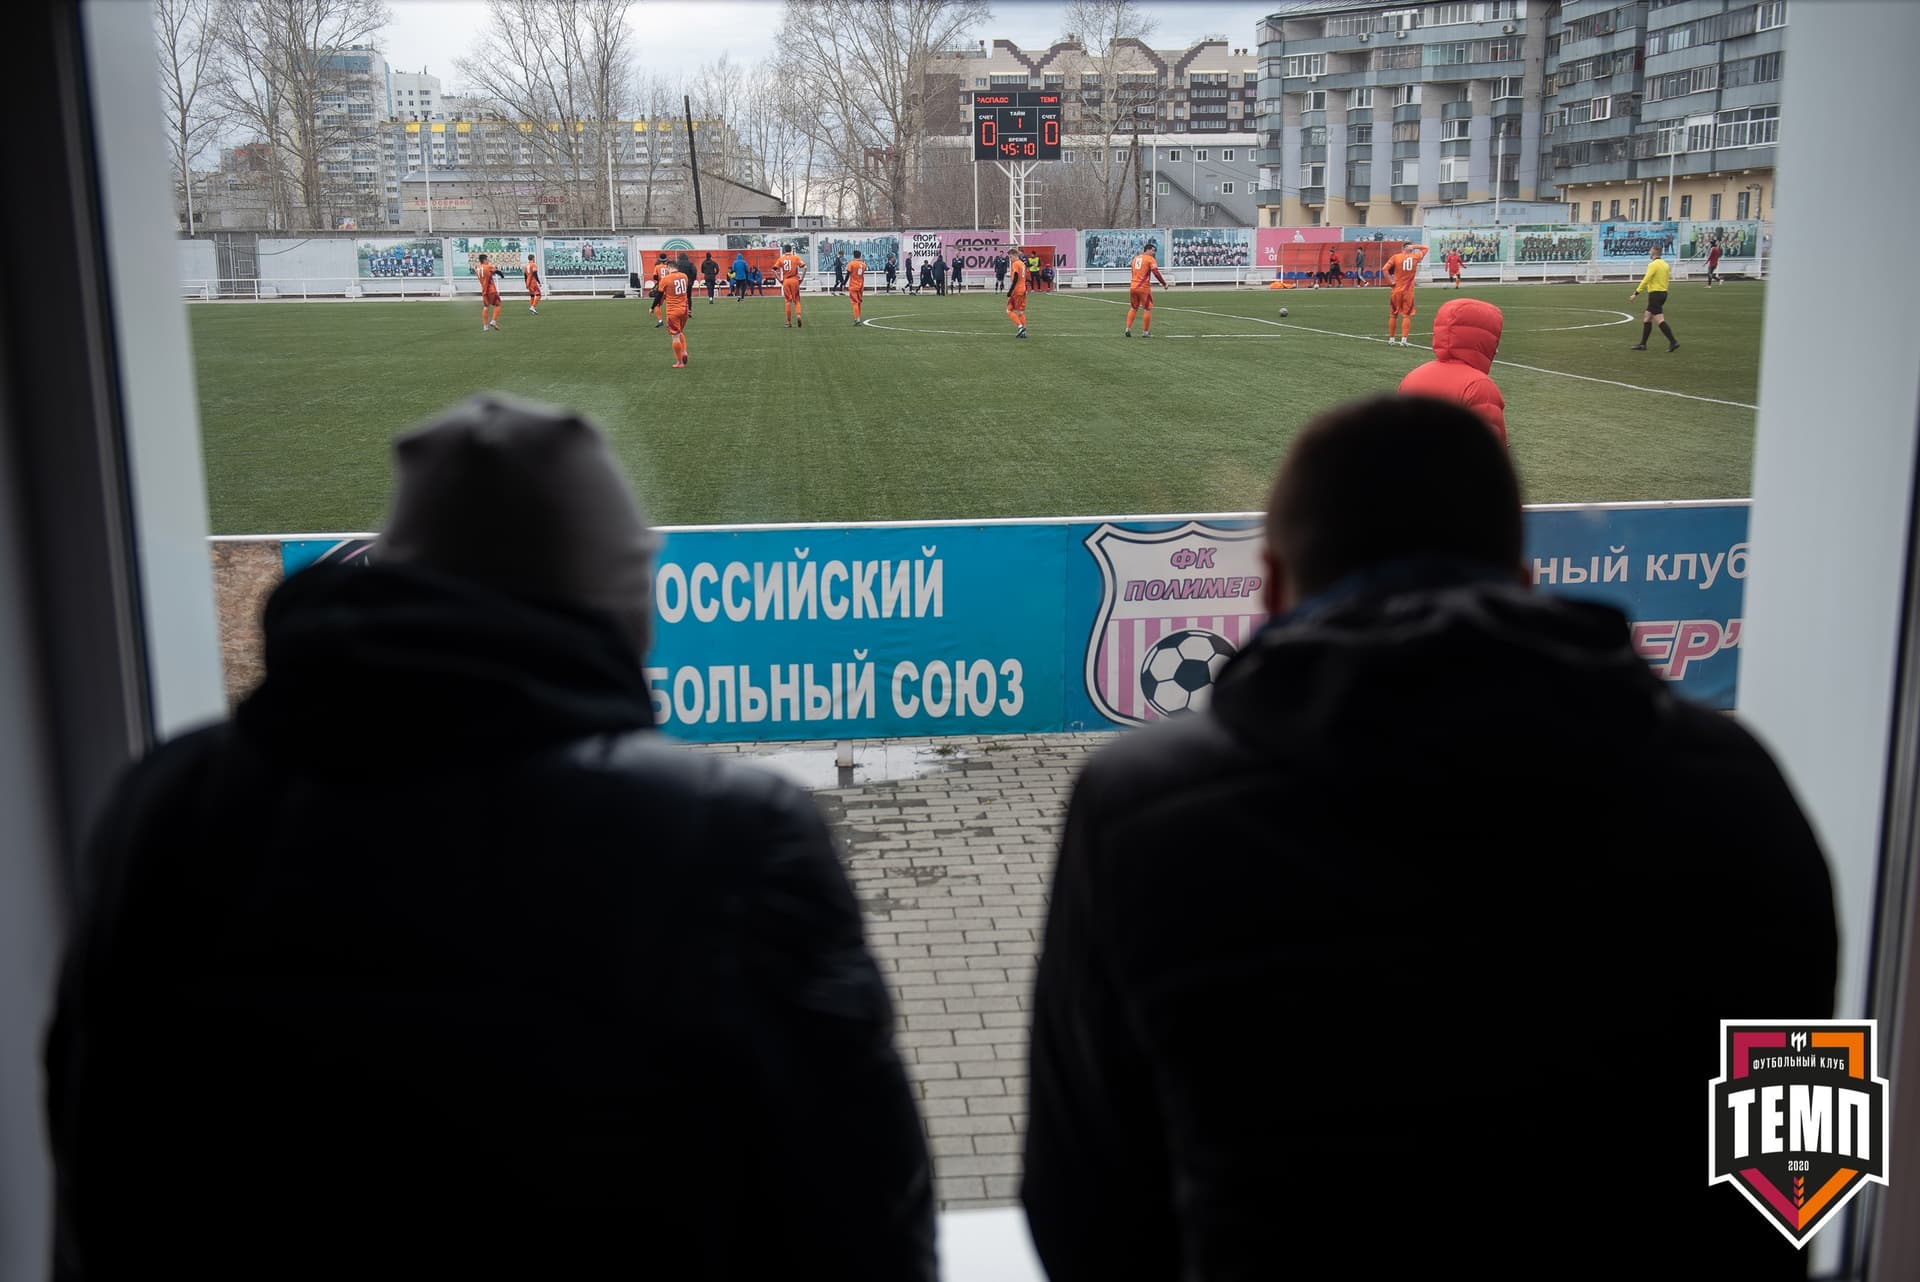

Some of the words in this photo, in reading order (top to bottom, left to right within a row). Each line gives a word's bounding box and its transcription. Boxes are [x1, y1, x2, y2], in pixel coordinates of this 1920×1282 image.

[1018, 117, 1022, 129] 1
[982, 121, 996, 146] 0
[1044, 120, 1059, 146] 0
[1000, 142, 1036, 156] 45:10
[913, 234, 937, 242] СПОРТ
[955, 238, 1000, 251] СПОРТ
[913, 242, 942, 250] НОРМА
[913, 250, 942, 258] ЖИЗНИ
[783, 259, 792, 273] 21
[673, 278, 687, 295] 20
[1170, 547, 1218, 570] ФК
[1646, 542, 1750, 590] клуб
[1124, 576, 1262, 602] ПОЛИМЕР
[891, 658, 1024, 719] СОЮЗ
